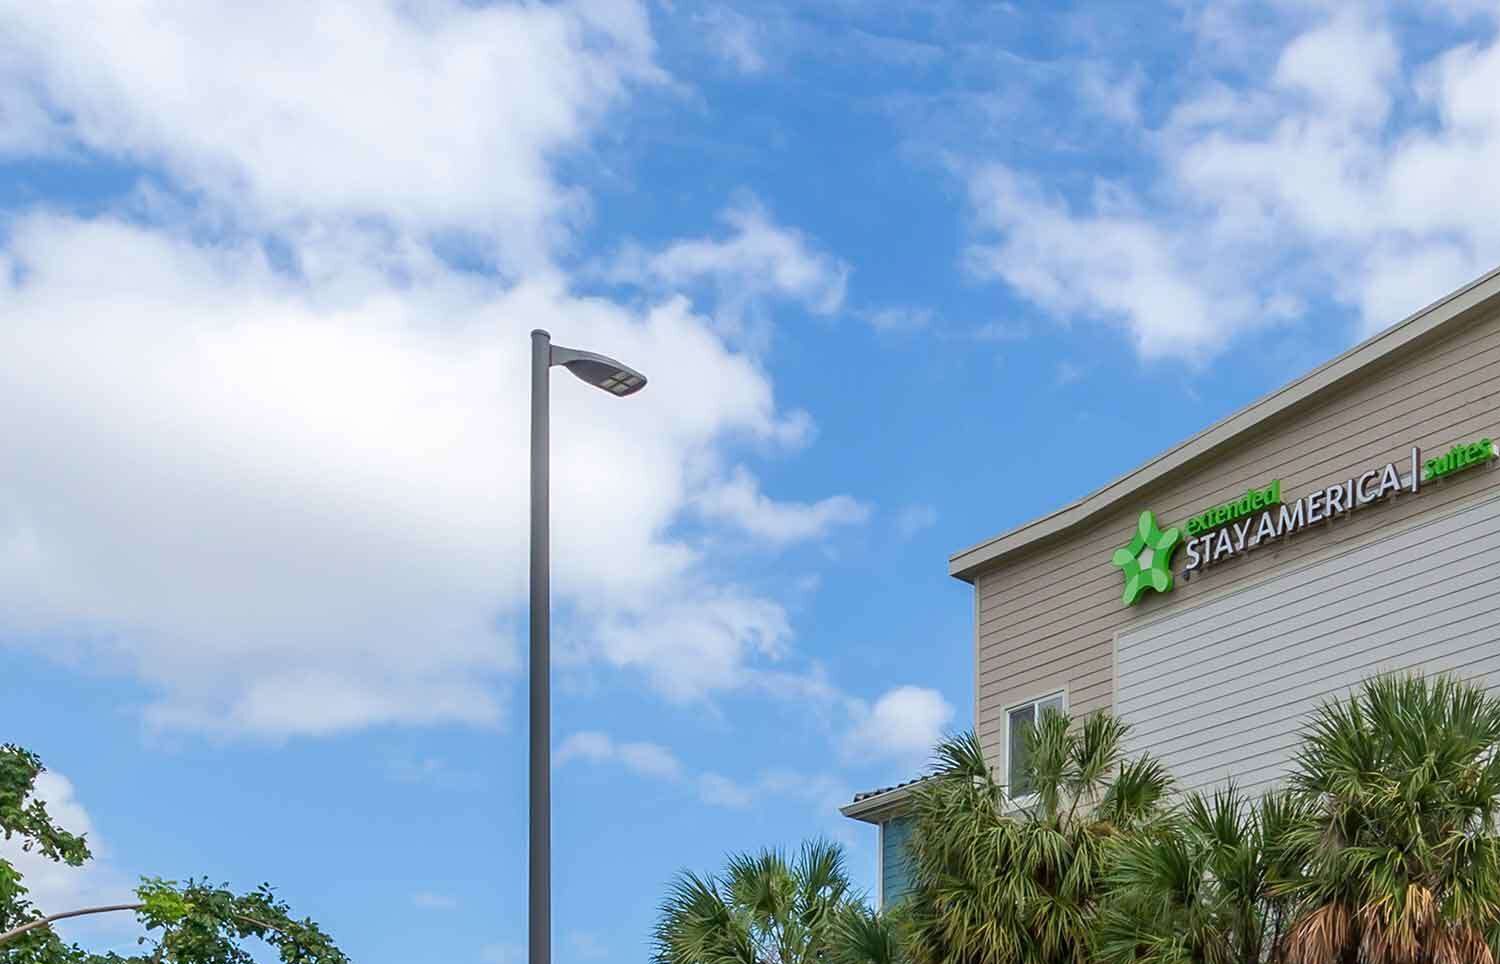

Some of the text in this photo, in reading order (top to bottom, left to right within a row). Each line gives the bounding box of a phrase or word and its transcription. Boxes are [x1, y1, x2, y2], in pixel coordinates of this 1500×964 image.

[1184, 479, 1281, 536] extended
[1186, 438, 1494, 570] STAY AMERICA suites
